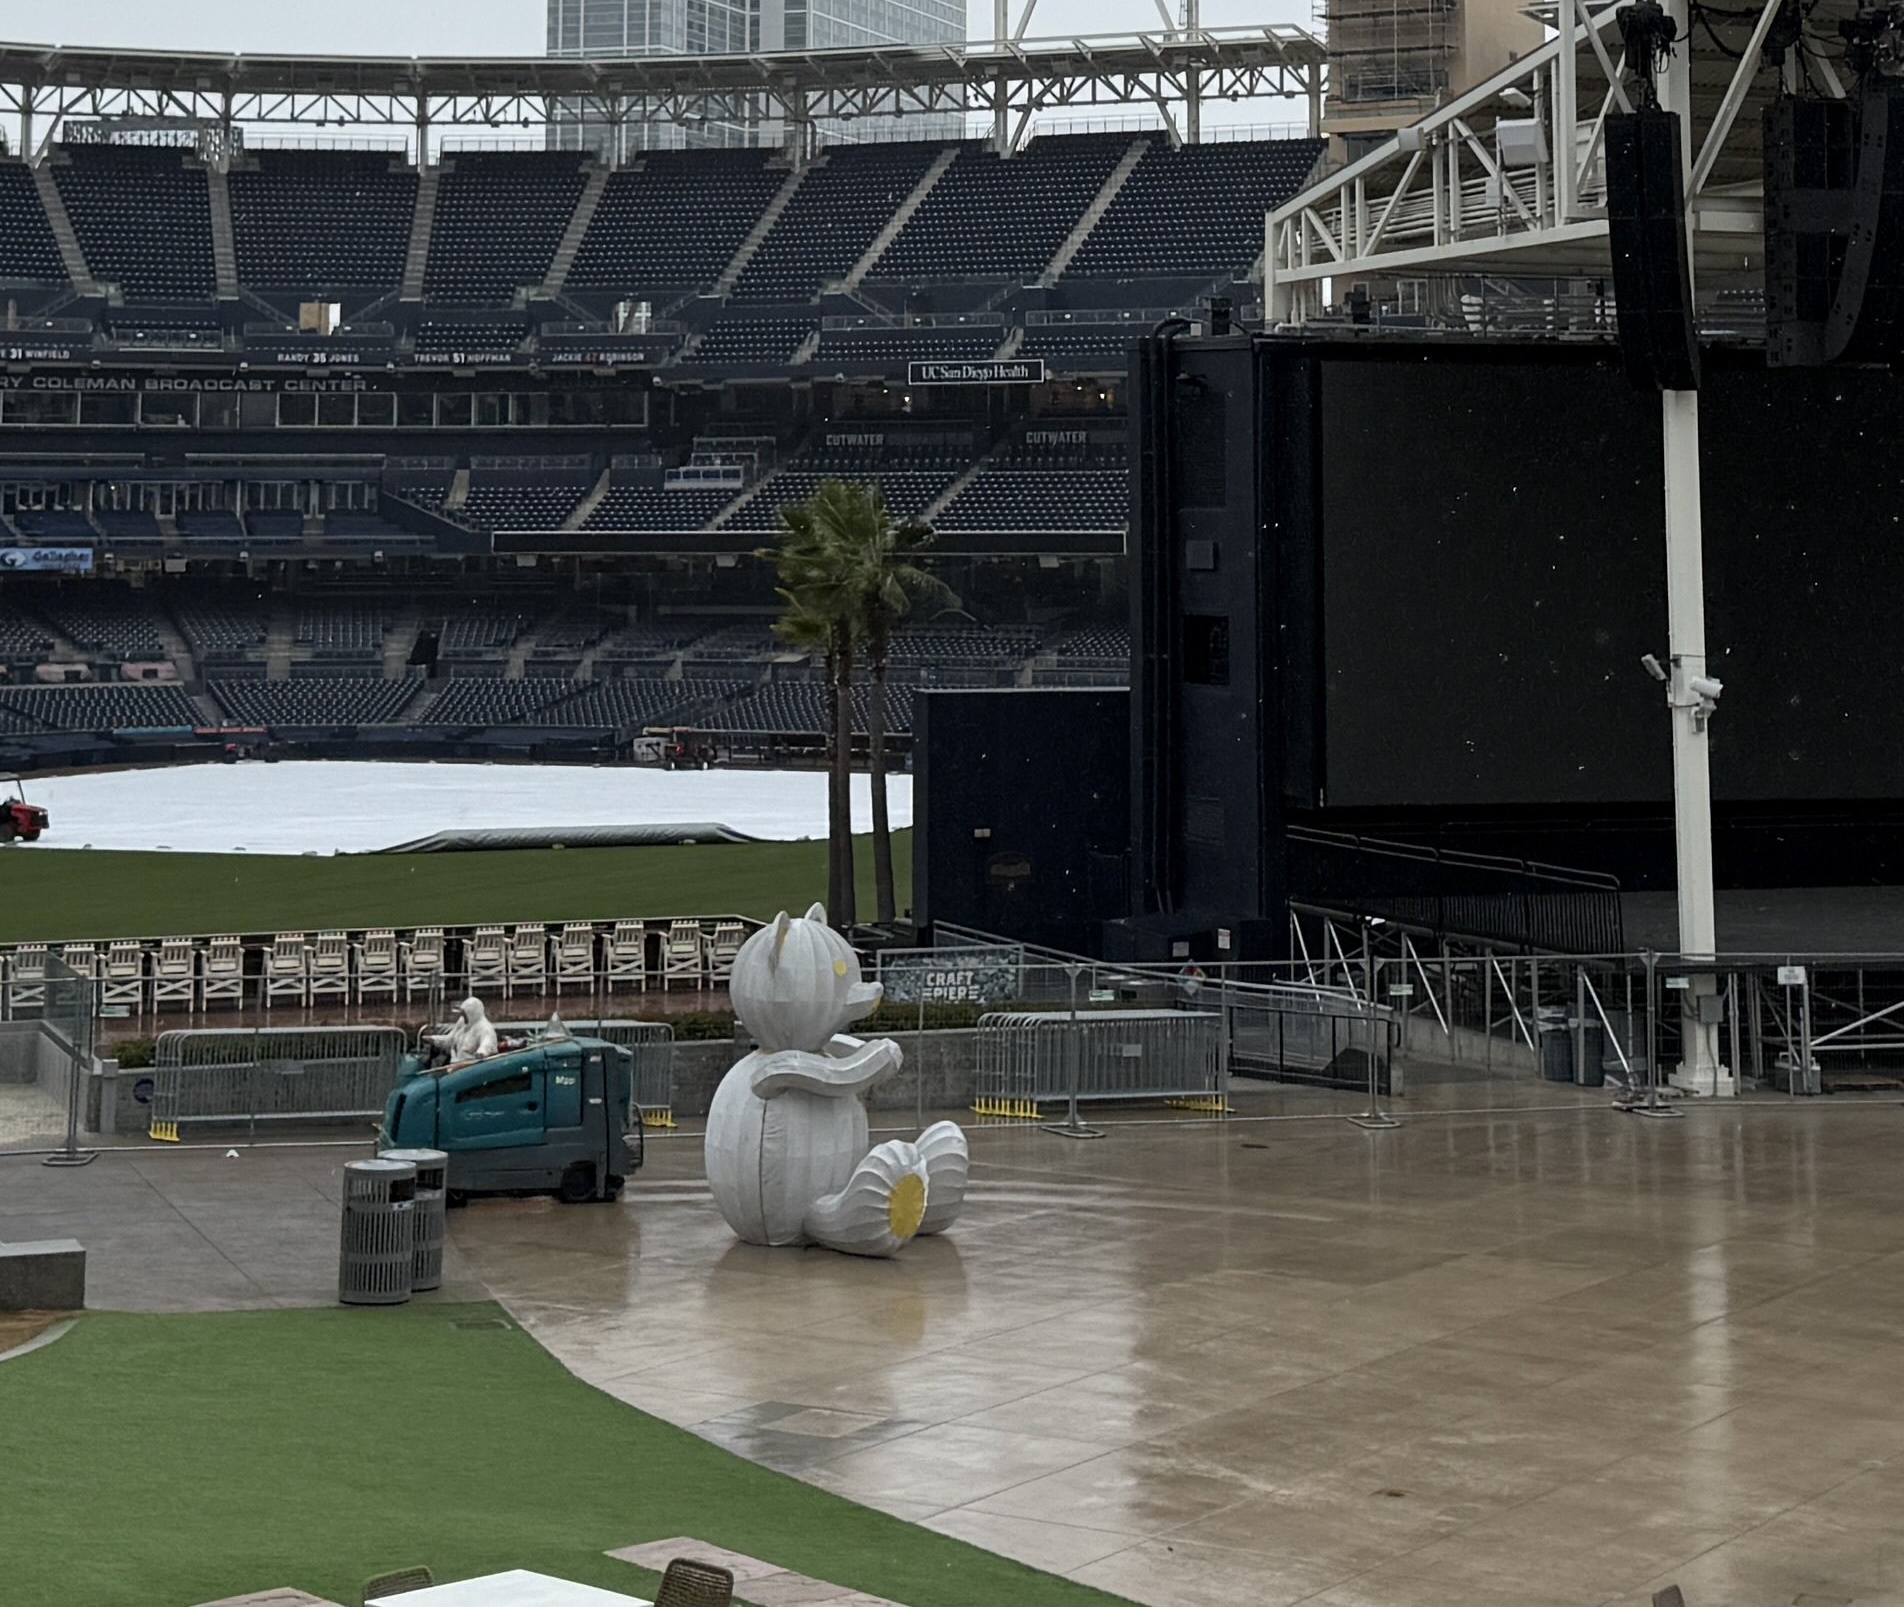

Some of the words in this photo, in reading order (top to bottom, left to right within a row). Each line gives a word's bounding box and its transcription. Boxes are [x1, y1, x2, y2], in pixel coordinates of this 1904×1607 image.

[10, 348, 23, 359] 31
[25, 349, 70, 359] WINFIELD
[312, 353, 326, 363] 35
[329, 354, 359, 363] JONES
[414, 353, 449, 363] TREVOR
[453, 353, 465, 364] 51
[468, 353, 511, 363] HOFFMAN
[552, 353, 582, 362] JACKIE
[922, 366, 938, 379] UC
[939, 366, 960, 379] San
[962, 365, 992, 382] Diego
[994, 365, 1028, 378] Health
[33, 376, 136, 390] COLEMAN
[145, 378, 275, 391] BROADCAST
[284, 379, 367, 391] CENTER
[826, 434, 884, 445] CUTWATER
[1026, 431, 1086, 444] CUTWATER
[926, 971, 975, 987] CRAFT
[933, 985, 968, 1000] PIER
